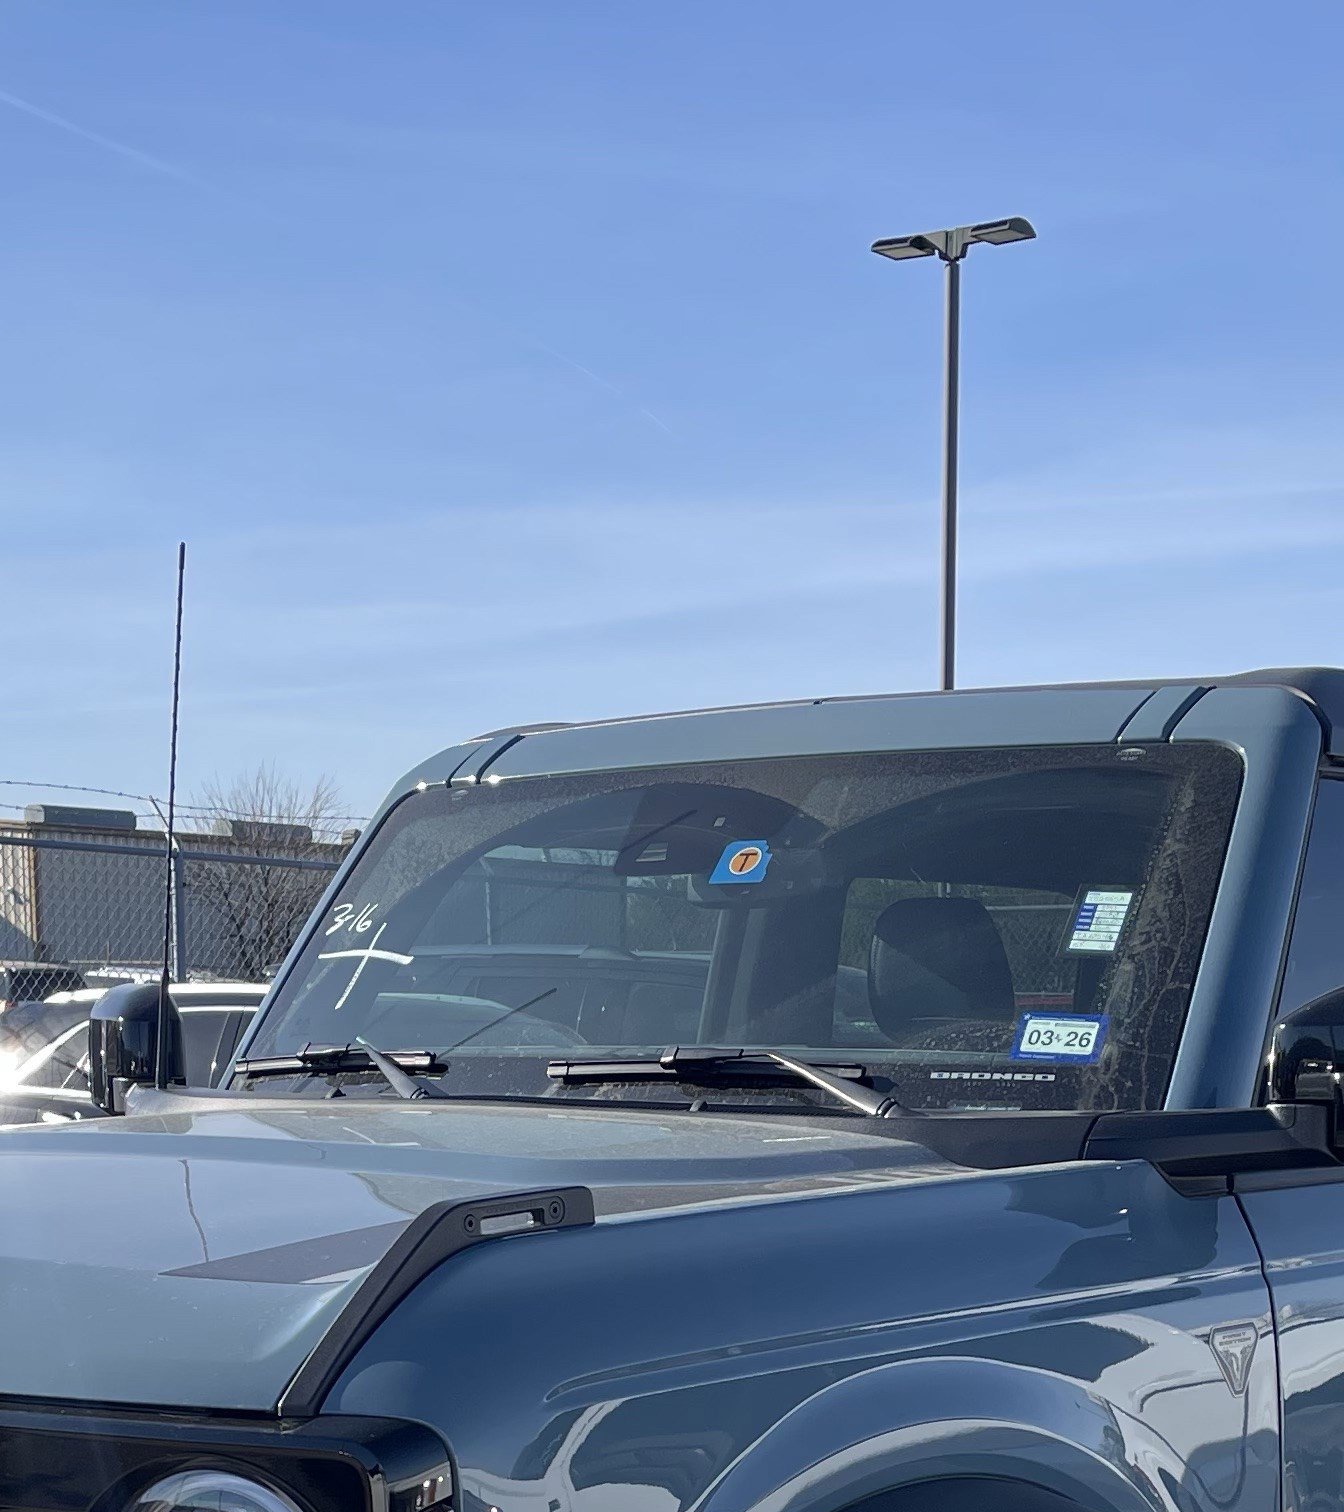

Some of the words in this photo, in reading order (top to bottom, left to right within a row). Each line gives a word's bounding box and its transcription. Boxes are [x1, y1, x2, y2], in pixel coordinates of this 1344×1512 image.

[1027, 1029, 1055, 1046] 03
[1064, 1031, 1093, 1048] 26
[930, 1072, 1056, 1082] BRONCO
